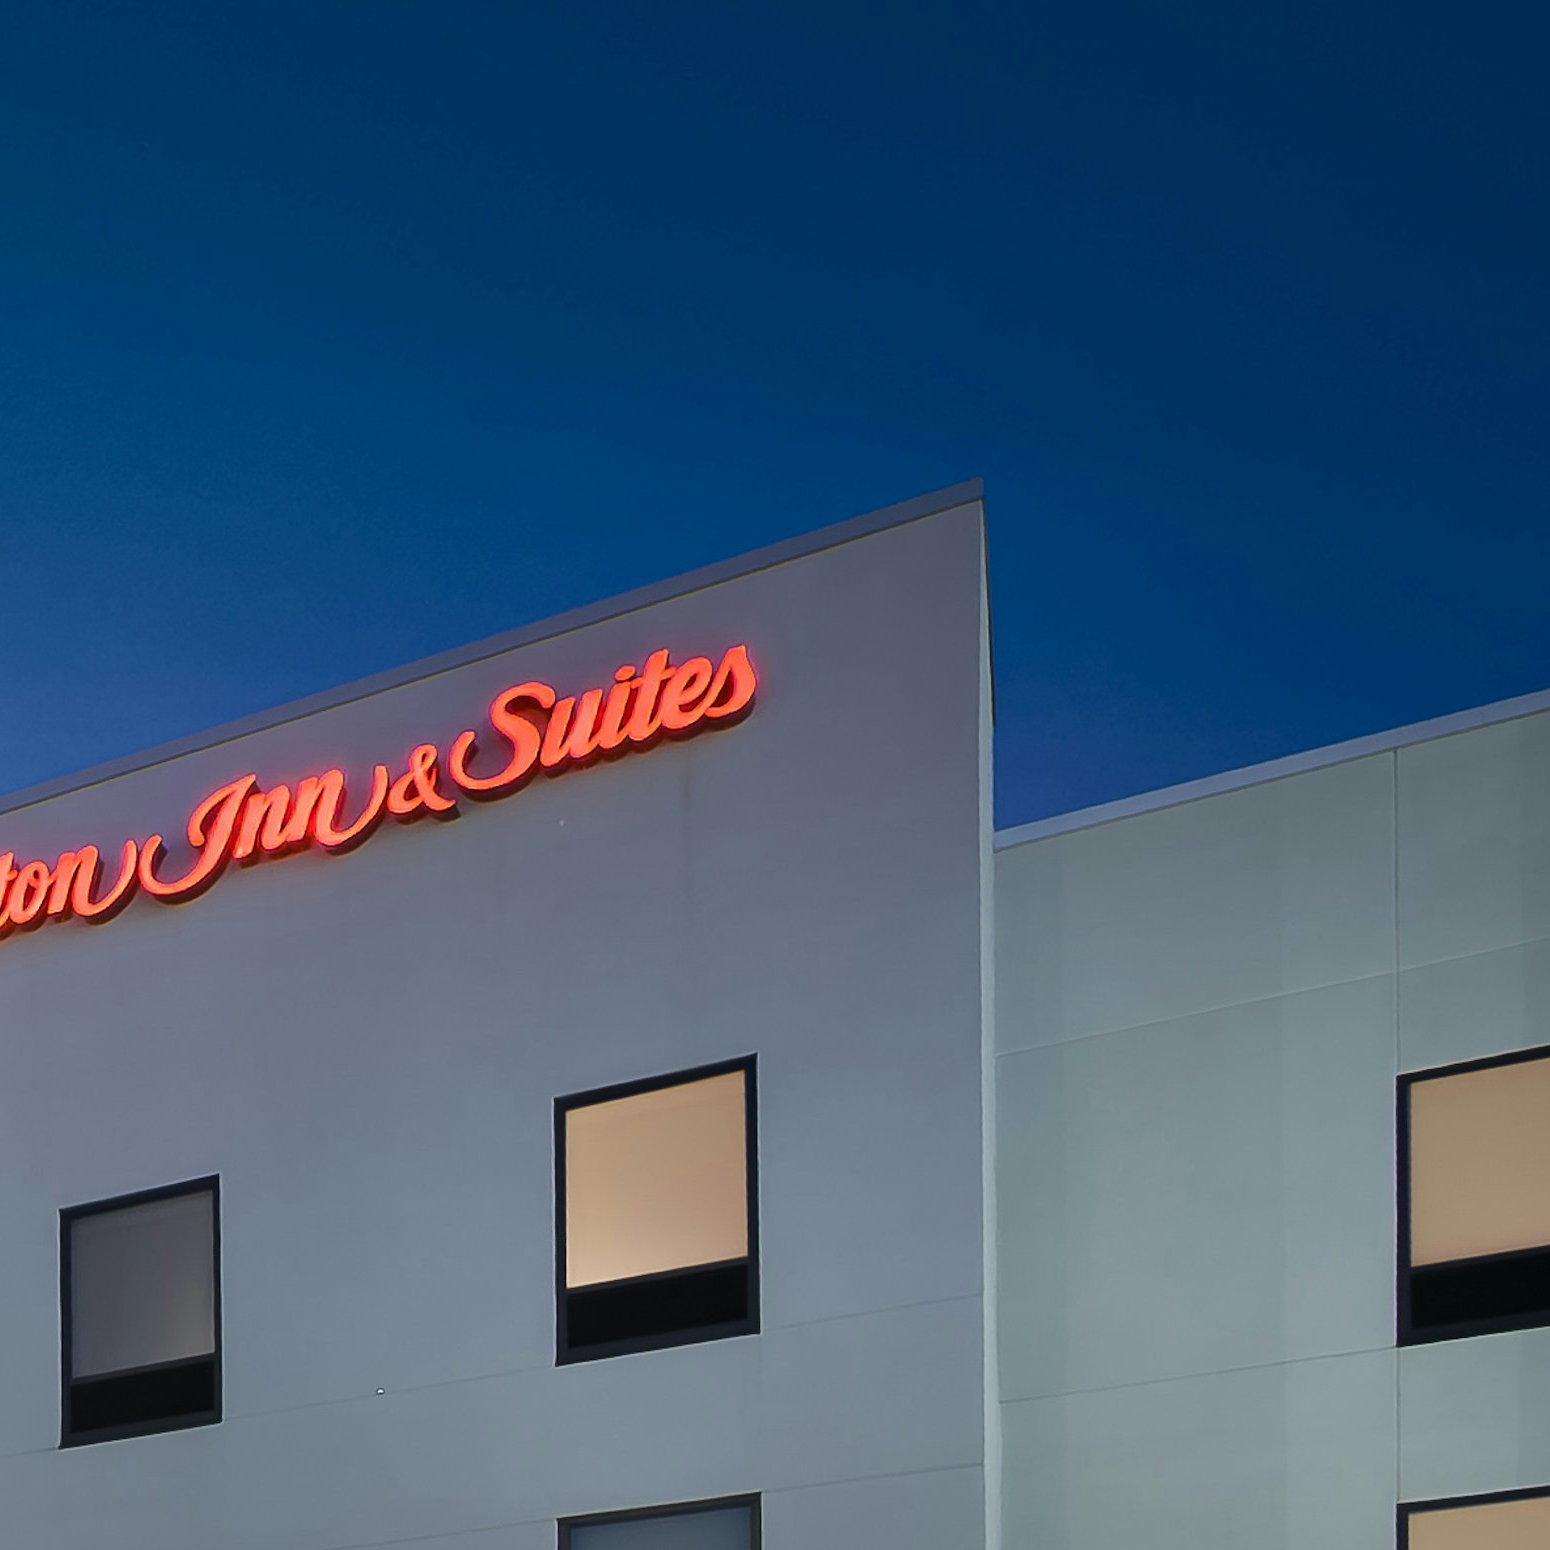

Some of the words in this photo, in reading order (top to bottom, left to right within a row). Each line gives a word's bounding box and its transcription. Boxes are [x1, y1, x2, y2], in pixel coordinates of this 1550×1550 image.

[137, 765, 388, 896] Inn
[387, 744, 457, 815] &
[449, 644, 757, 791] Suites
